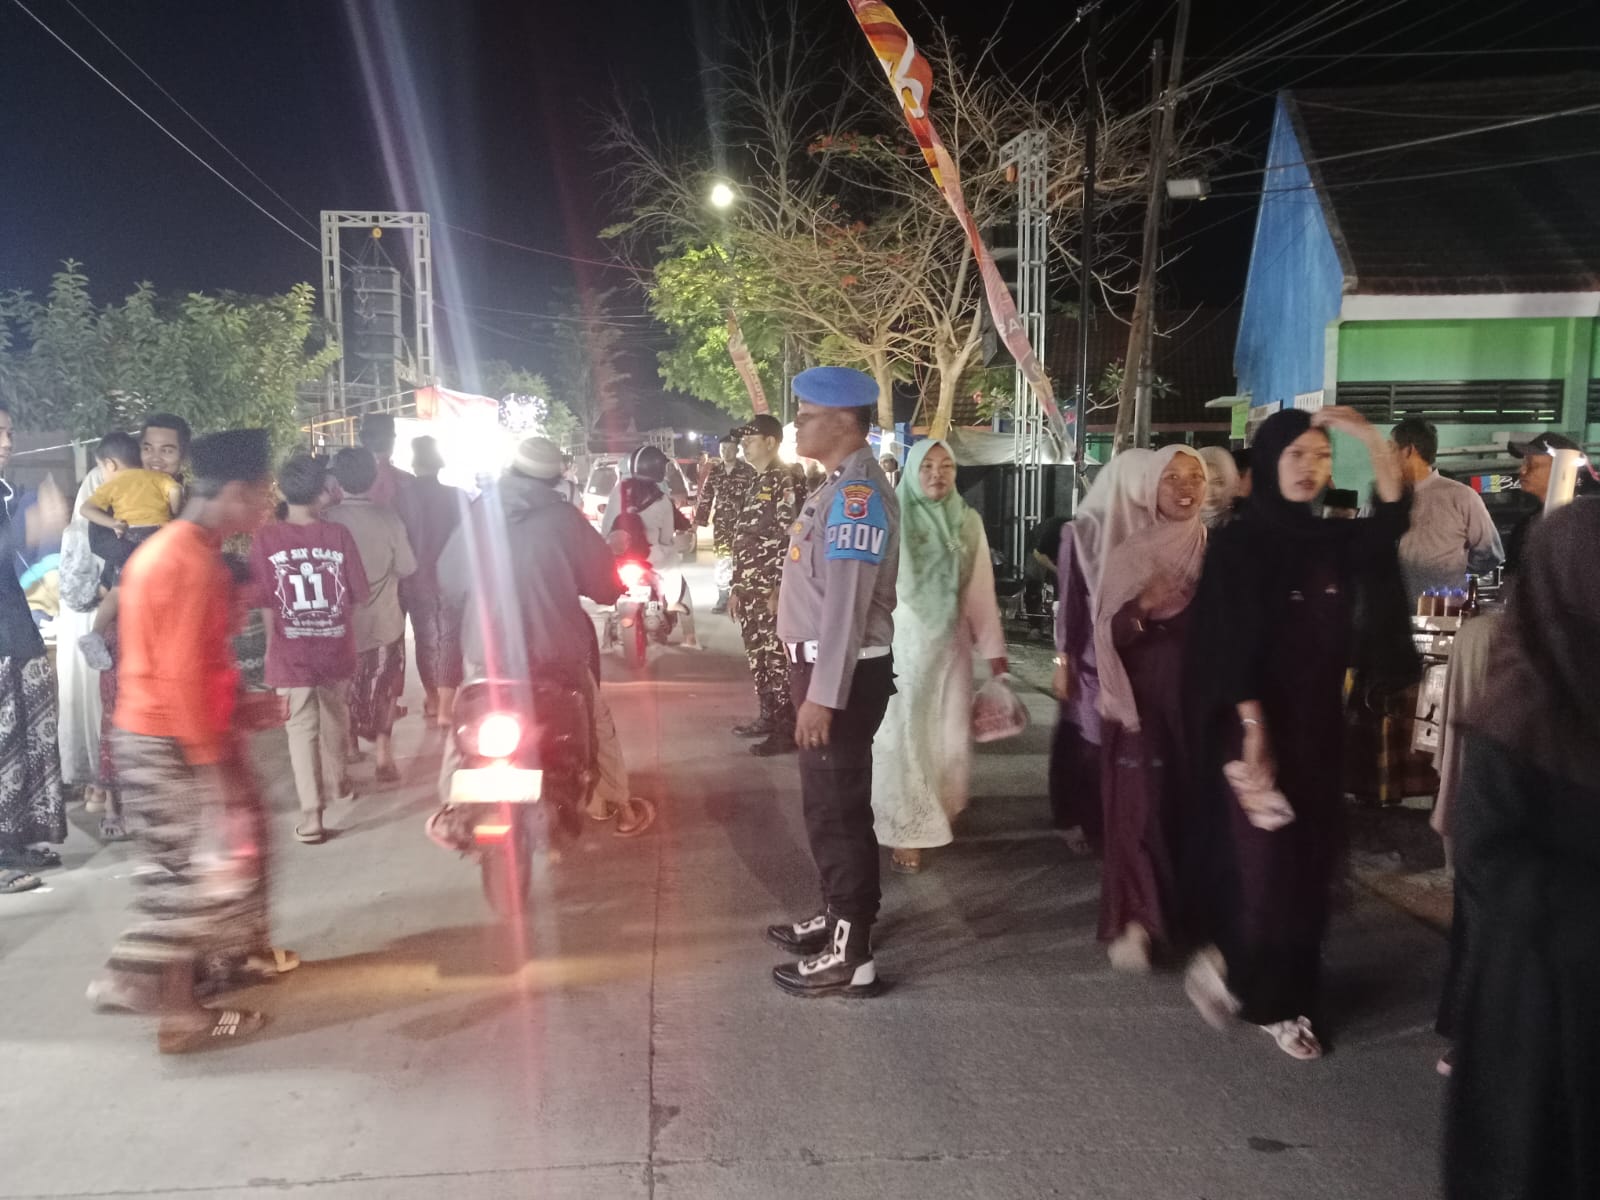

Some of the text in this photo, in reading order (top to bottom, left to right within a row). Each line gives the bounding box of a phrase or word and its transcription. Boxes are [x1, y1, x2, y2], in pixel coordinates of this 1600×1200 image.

[826, 522, 885, 554] PROV
[291, 548, 308, 559] SIX
[312, 547, 344, 563] CLASS
[289, 574, 328, 610] 11
